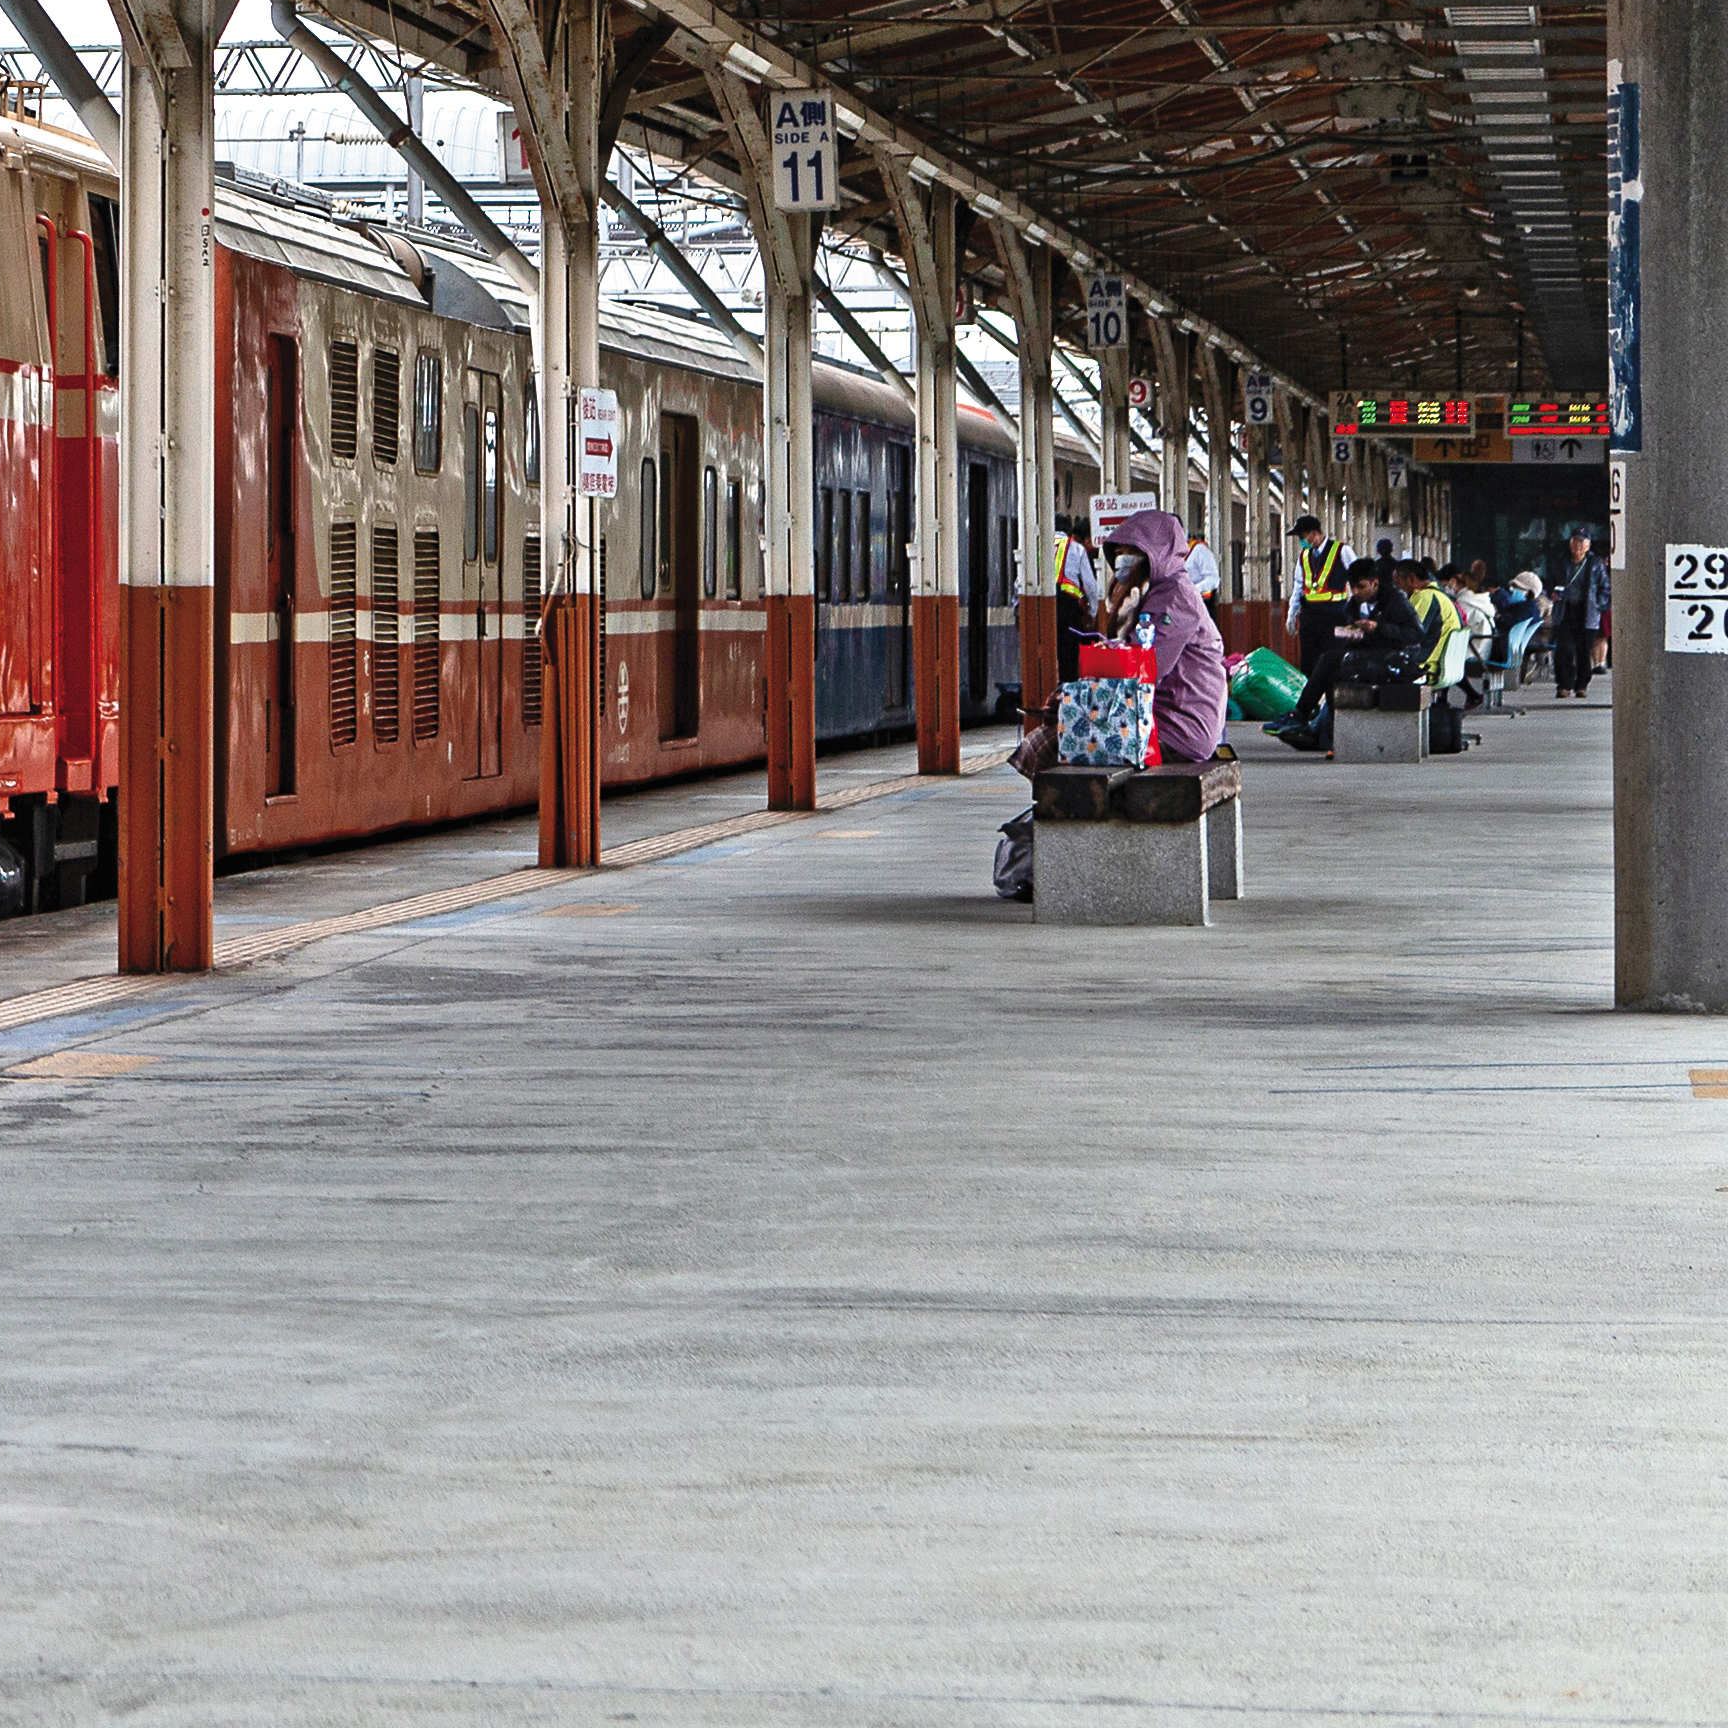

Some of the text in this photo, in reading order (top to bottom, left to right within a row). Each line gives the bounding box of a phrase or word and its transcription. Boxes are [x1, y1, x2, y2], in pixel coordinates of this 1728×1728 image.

[776, 100, 827, 129] A側
[774, 131, 829, 145] SIDE A
[782, 150, 824, 203] 11
[1090, 312, 1122, 346] 10
[1129, 380, 1147, 404] 9
[1250, 397, 1268, 421] 9
[1335, 442, 1350, 462] 8
[1391, 471, 1402, 487] 7
[1688, 604, 1728, 640] 2
